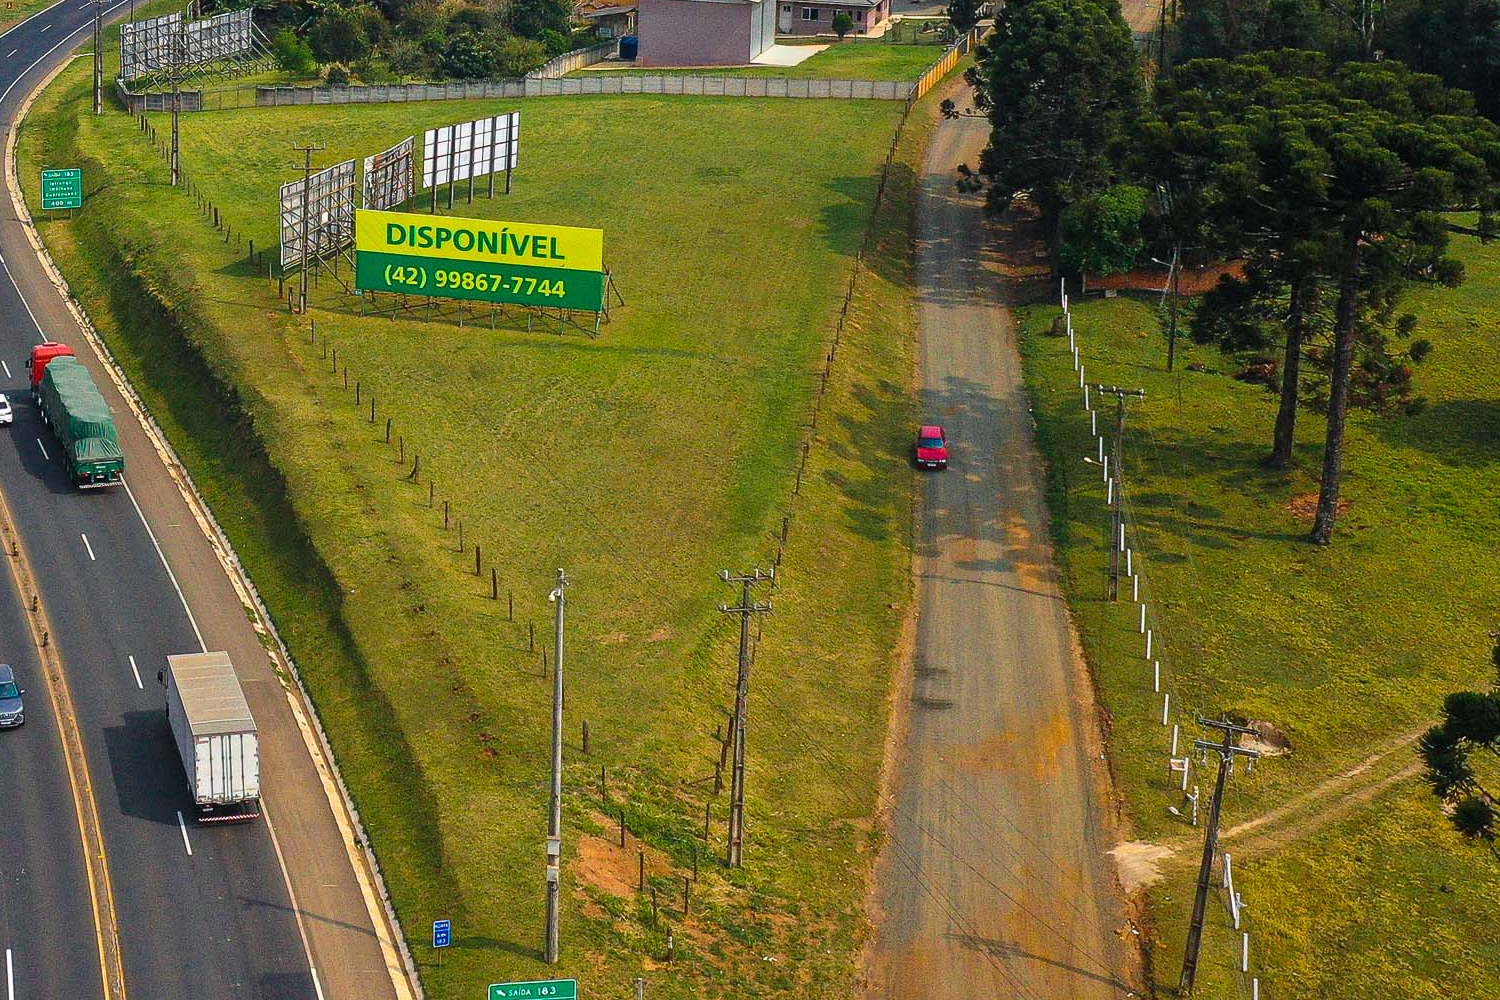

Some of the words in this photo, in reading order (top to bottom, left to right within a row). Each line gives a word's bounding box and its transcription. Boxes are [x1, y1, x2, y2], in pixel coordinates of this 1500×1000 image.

[386, 223, 566, 260] DISPONÍVEL
[384, 263, 427, 288] (42)
[434, 269, 566, 298] 99867-7744
[508, 987, 531, 997] SAÍDA
[538, 986, 556, 996] 183
